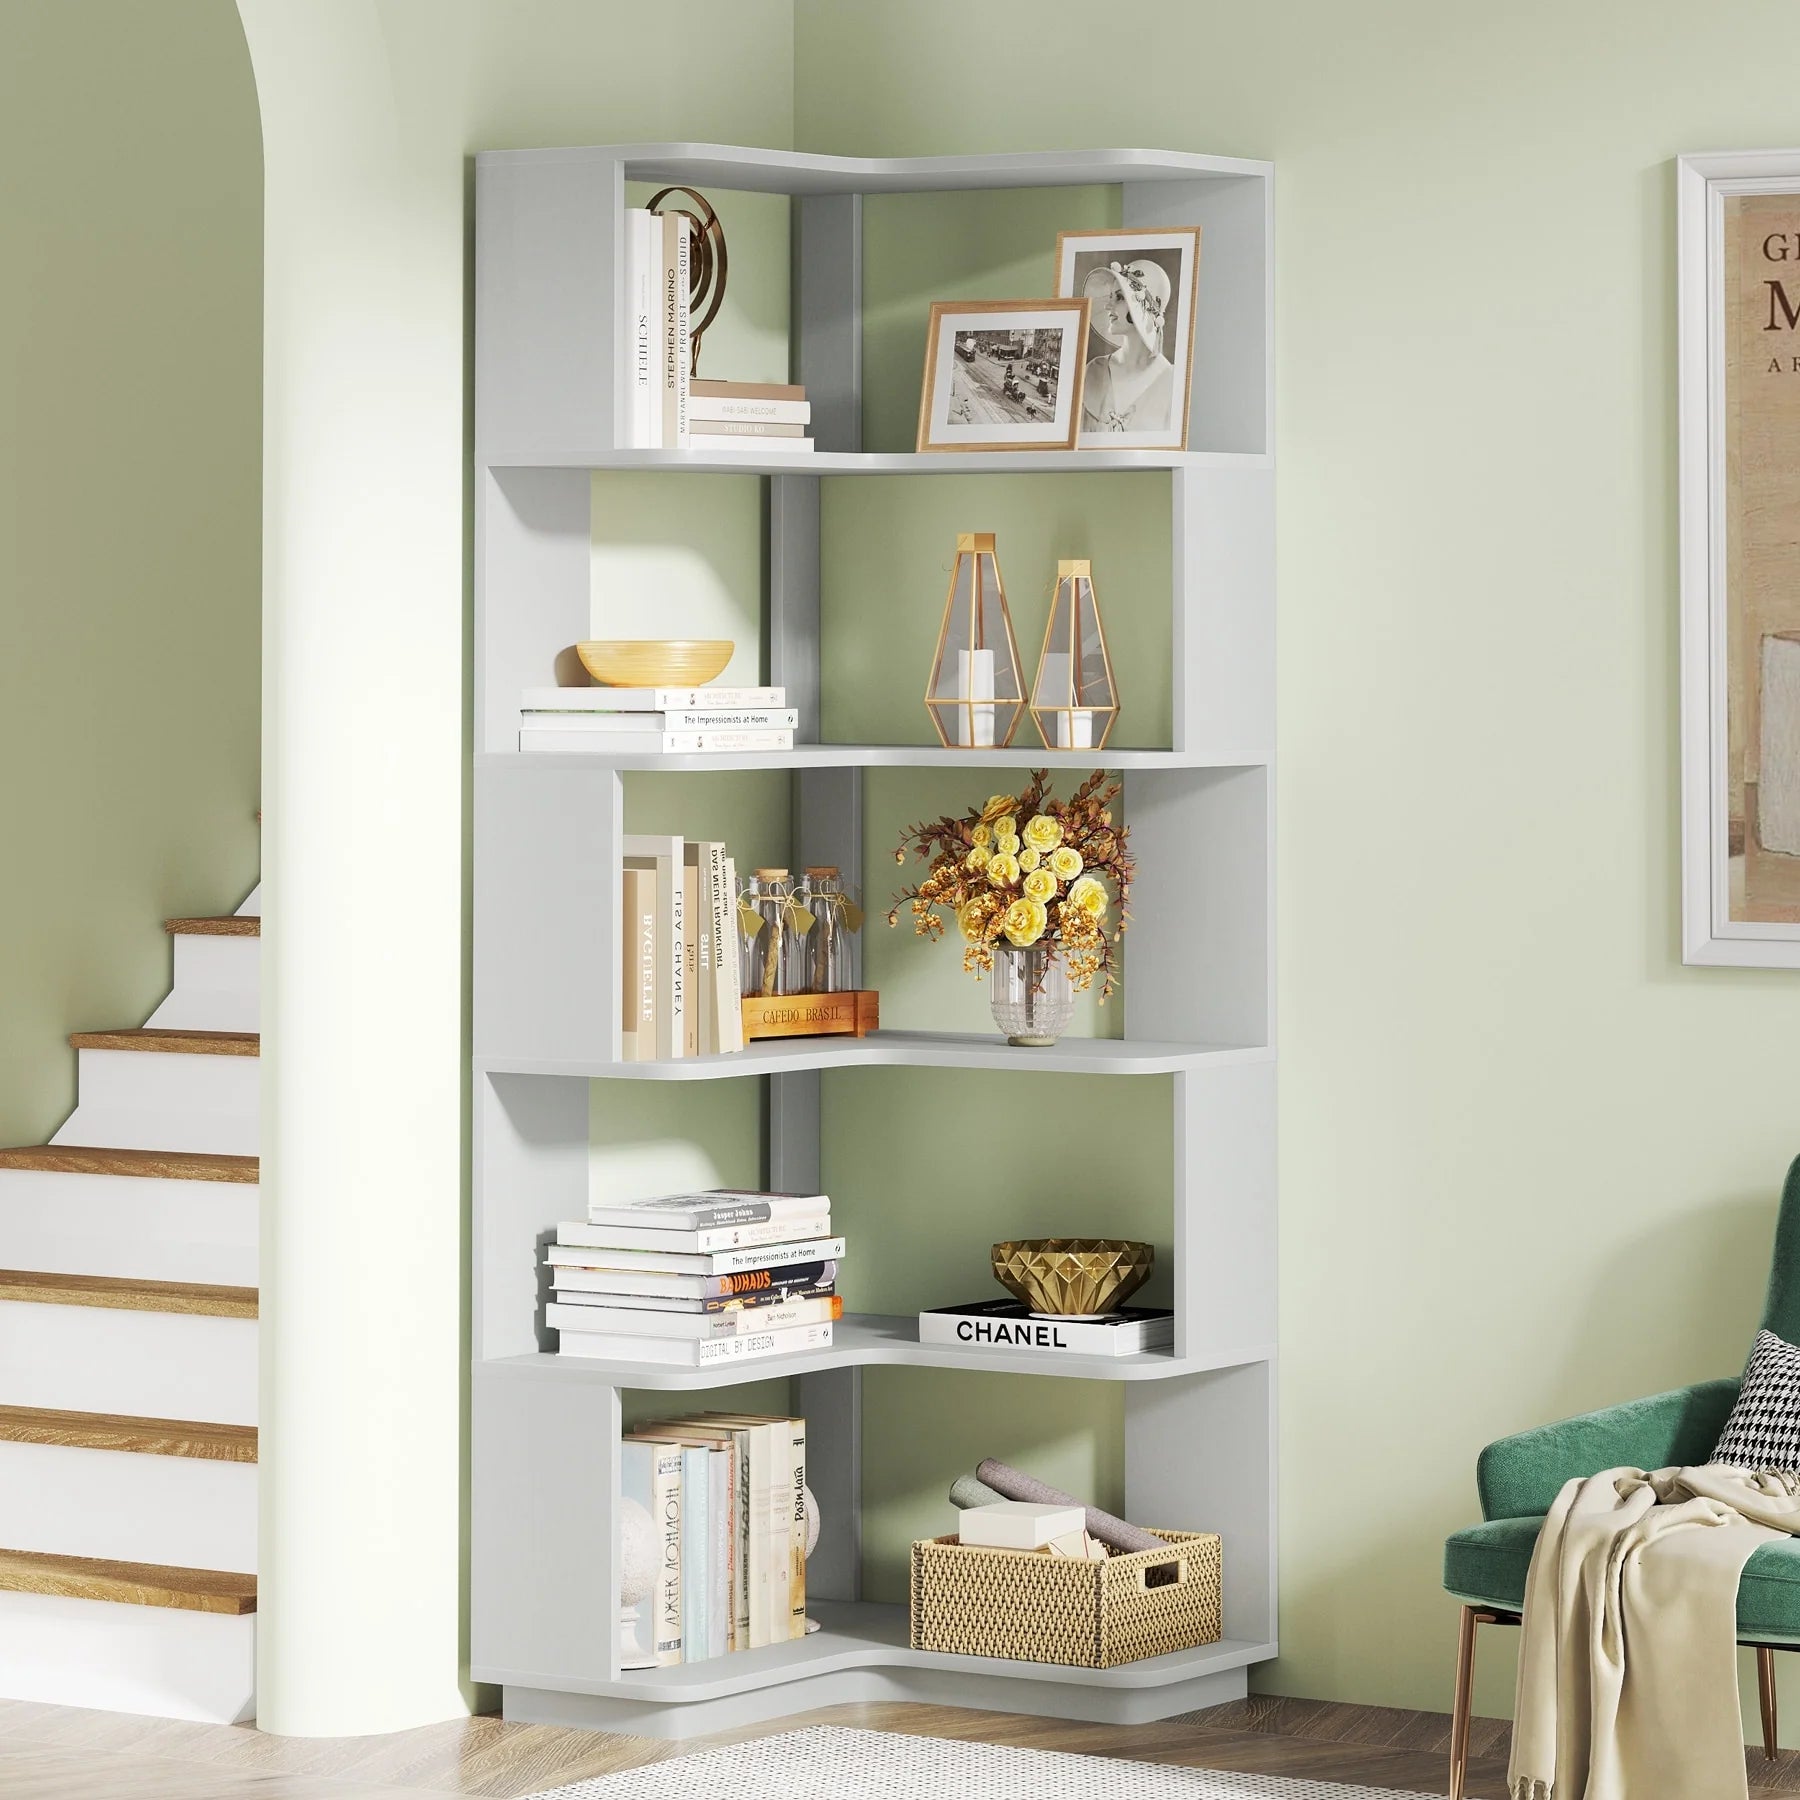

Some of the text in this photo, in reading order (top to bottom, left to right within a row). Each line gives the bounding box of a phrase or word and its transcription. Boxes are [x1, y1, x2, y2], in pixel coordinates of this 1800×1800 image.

[679, 236, 687, 275] SQUID
[667, 268, 675, 389] STEPHEN MARINO
[679, 304, 687, 353] PROUST
[638, 315, 648, 387] SCHIELE
[724, 424, 765, 433] STUDIO KO
[684, 715, 696, 724] The
[697, 715, 742, 725] Impressionists
[750, 715, 768, 723] Home
[763, 1006, 841, 1024] CAFEDO BRASIL
[713, 1208, 753, 1220] Jasper Johns
[732, 1248, 816, 1266] The Impressionists at Home
[719, 1271, 771, 1293] BAUHAUS
[707, 1296, 757, 1310] DAA
[956, 1320, 1067, 1348] CHANEL
[701, 1336, 775, 1359] DIGITAL BY DESIGN
[664, 1488, 680, 1572] ЛОНДОН
[664, 1575, 680, 1626] ДЖЕК
